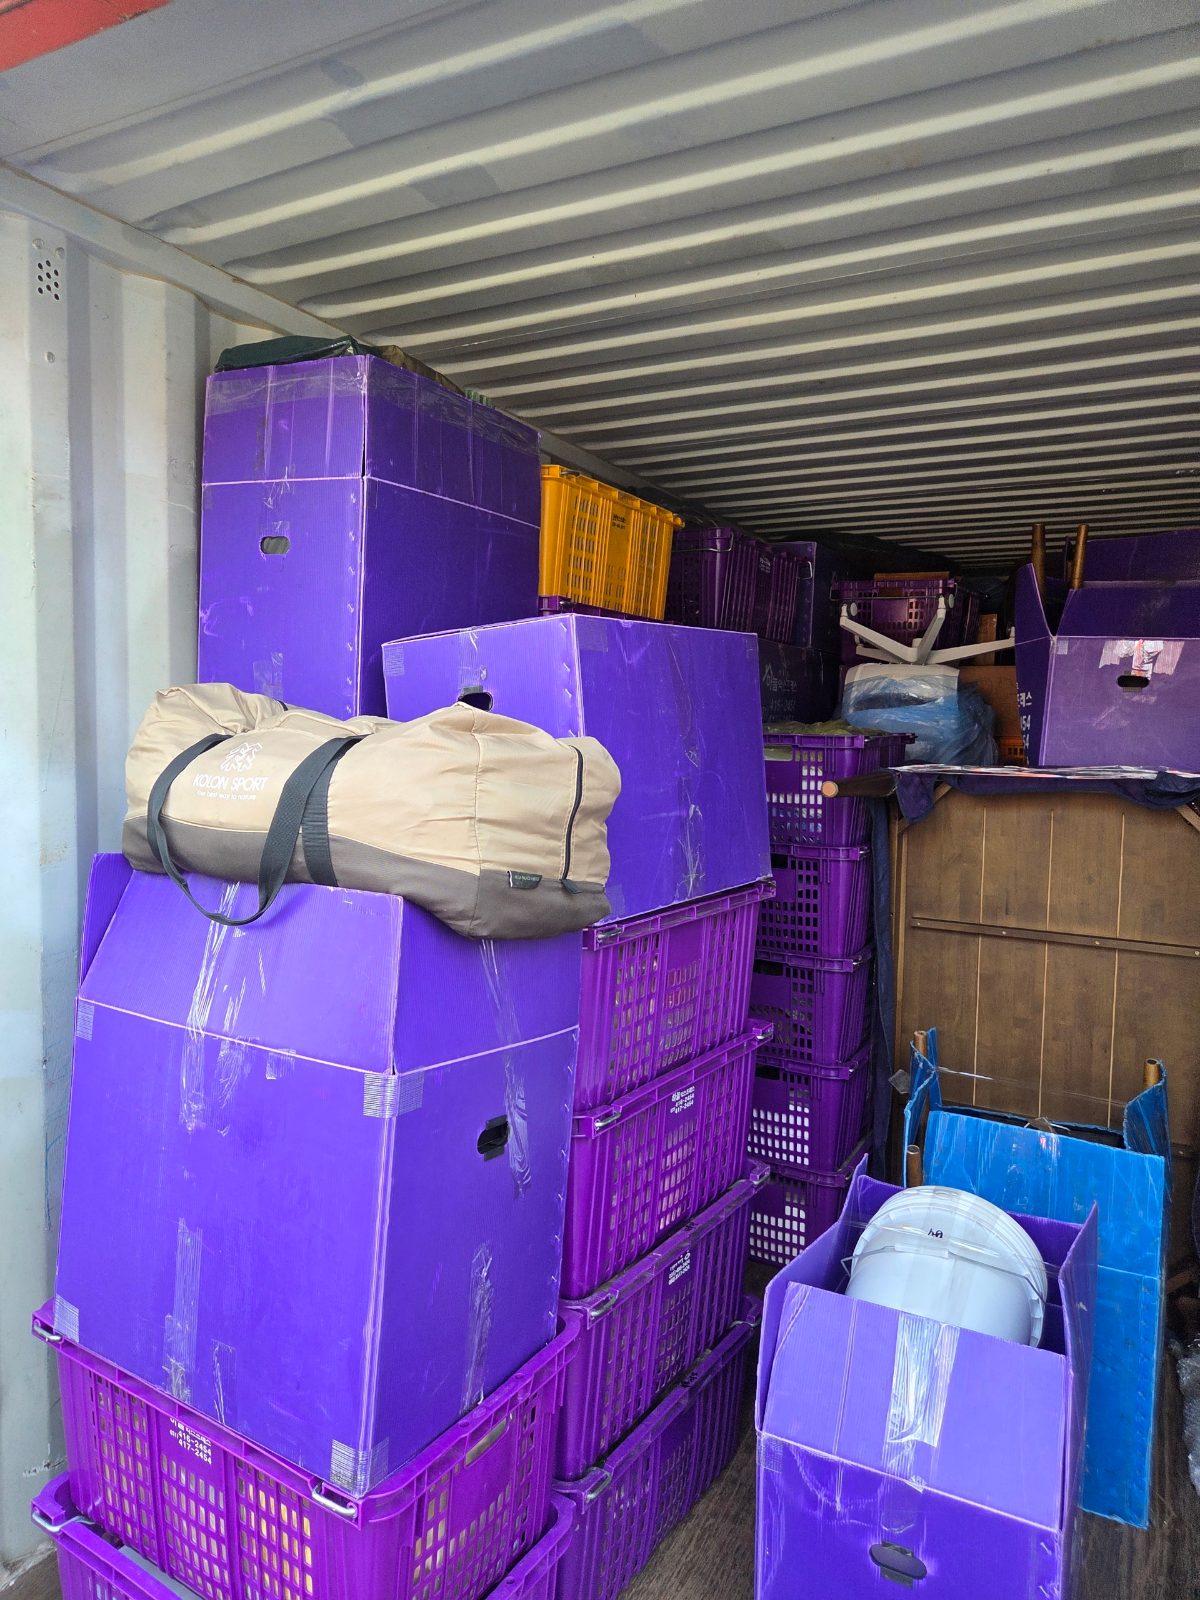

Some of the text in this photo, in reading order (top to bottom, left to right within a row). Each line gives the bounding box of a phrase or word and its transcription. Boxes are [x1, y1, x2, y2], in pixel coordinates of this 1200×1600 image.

[192, 773, 269, 792] KOLON SPORT
[178, 1430, 212, 1456] 416-2454
[178, 1439, 212, 1464] 417-2454
